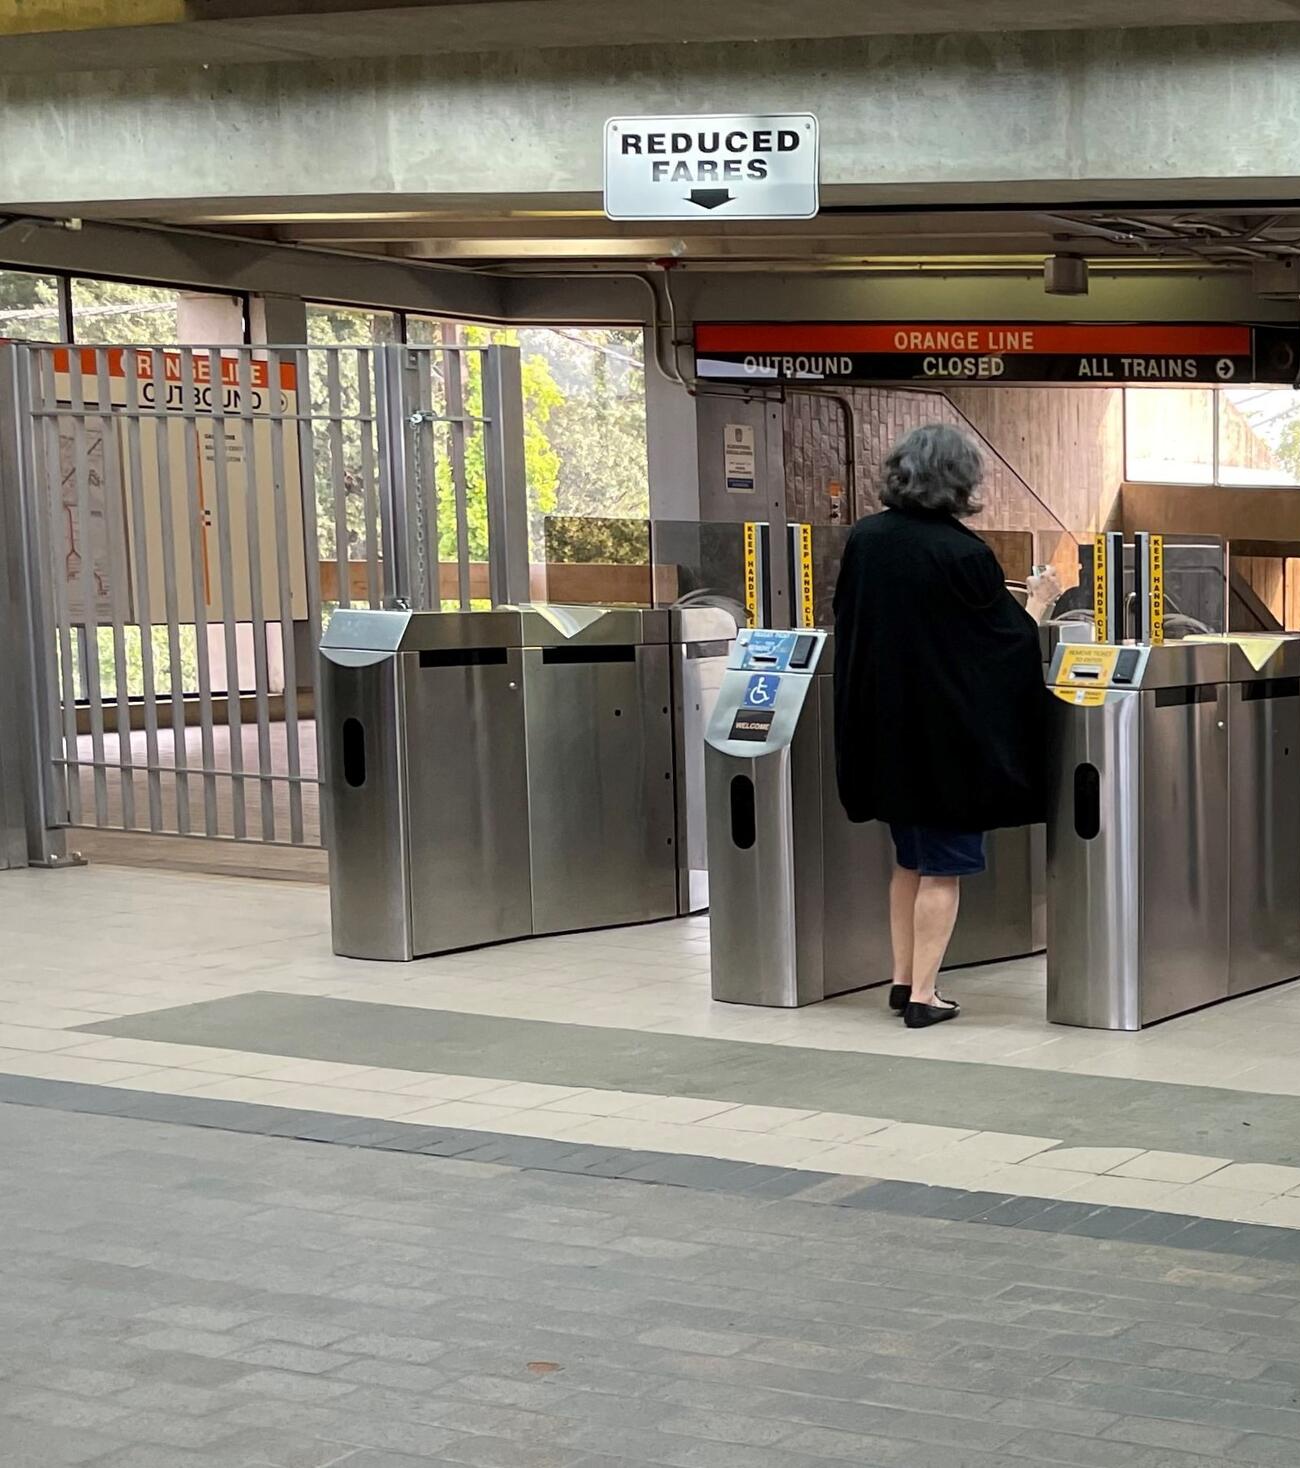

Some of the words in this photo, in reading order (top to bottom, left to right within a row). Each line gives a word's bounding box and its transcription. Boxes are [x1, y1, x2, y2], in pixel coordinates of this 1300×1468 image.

[621, 130, 801, 155] REDUCED
[652, 158, 768, 183] FARES
[894, 331, 980, 350] ORANGE
[988, 331, 1034, 350] LINE
[743, 355, 853, 376] OUTBOUND
[922, 356, 1005, 376] CLOSED
[1078, 358, 1114, 377] ALL
[1120, 358, 1198, 378] TRAINS
[735, 721, 770, 731] WELCOME
